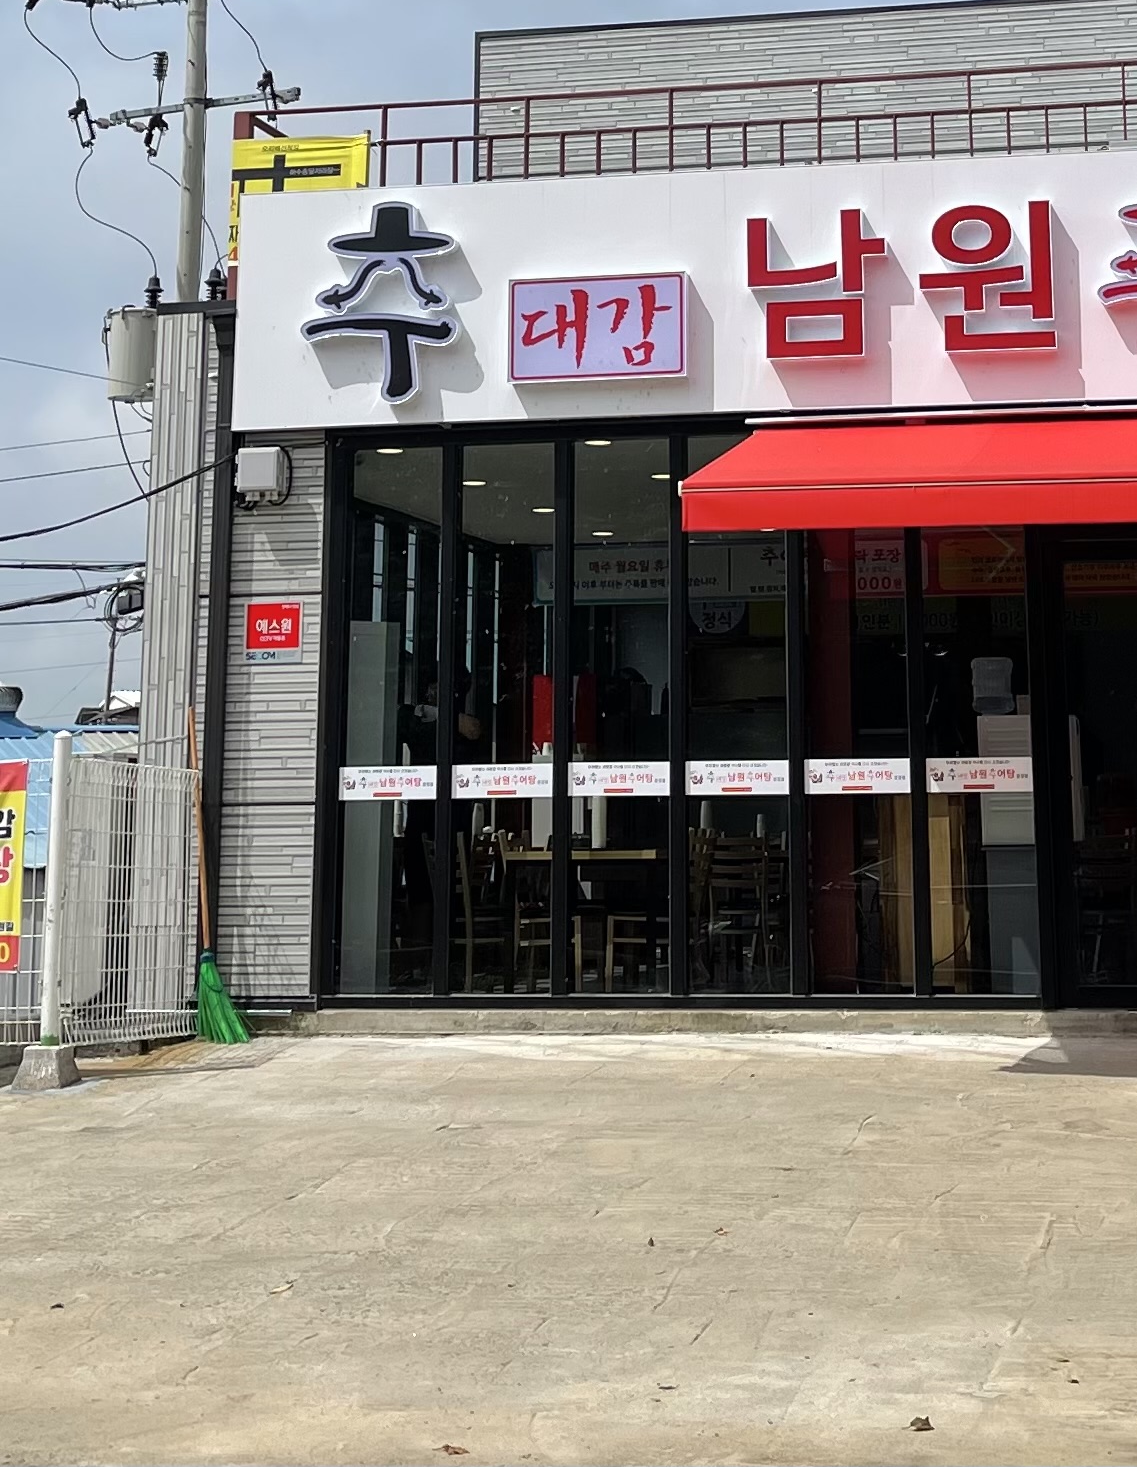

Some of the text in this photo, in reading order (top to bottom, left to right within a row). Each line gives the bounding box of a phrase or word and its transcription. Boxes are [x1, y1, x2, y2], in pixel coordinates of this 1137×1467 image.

[520, 281, 673, 369] 대감
[871, 547, 902, 563] 포장
[589, 561, 611, 573] 매주
[615, 559, 650, 573] 월요일
[255, 618, 292, 635] 에스원
[703, 611, 732, 629] 정식
